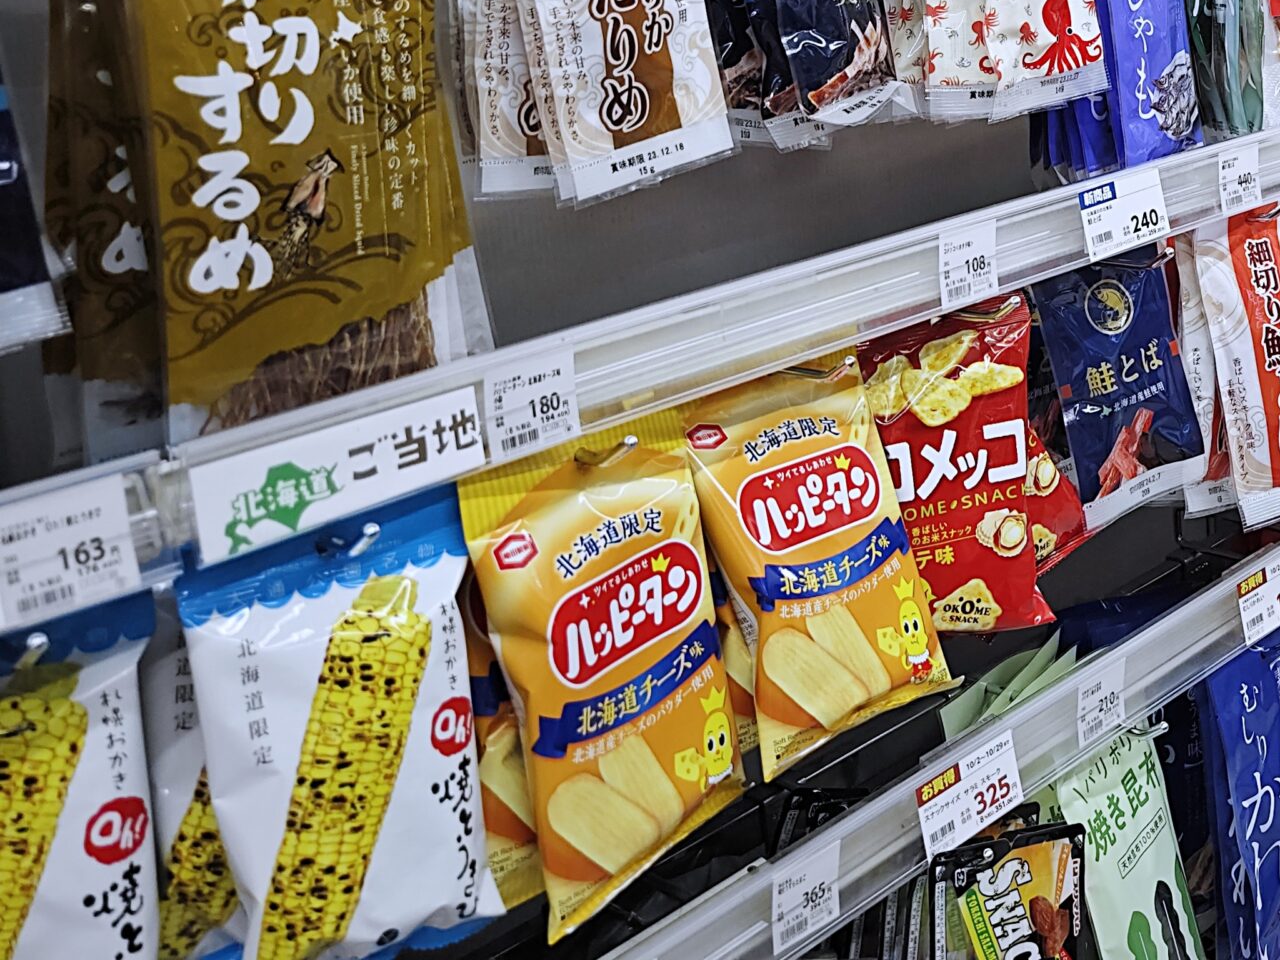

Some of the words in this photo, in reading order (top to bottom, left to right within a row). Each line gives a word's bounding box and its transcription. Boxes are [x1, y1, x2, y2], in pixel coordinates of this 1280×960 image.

[340, 46, 365, 126] いか使用
[173, 60, 274, 293] するめ
[610, 156, 646, 174] 賞味期限
[1083, 186, 1113, 207] 新商品
[1130, 208, 1160, 235] 240
[964, 255, 987, 275] 108
[1085, 339, 1164, 398] 鮭とば
[529, 391, 561, 418] 180
[347, 408, 482, 482] ご当地
[743, 416, 841, 464] 北海道限定
[885, 418, 1028, 503] コメッコ
[229, 466, 337, 524] 北海道
[751, 464, 880, 545] ハッピーターン
[57, 536, 106, 571] 163
[555, 507, 664, 580] 北海道限定
[779, 532, 891, 596] 北海道チーズ味
[566, 566, 699, 682] ハッピーターン
[942, 599, 992, 617] OKOME
[948, 613, 980, 625] SNACK
[236, 638, 276, 767] 北海道限定
[576, 641, 706, 738] 北海道チーズ味
[1098, 690, 1117, 713] 210
[99, 688, 130, 791] 札幌おかき
[920, 768, 957, 801] お買得
[973, 773, 1011, 816] 325
[802, 881, 827, 909] 365
